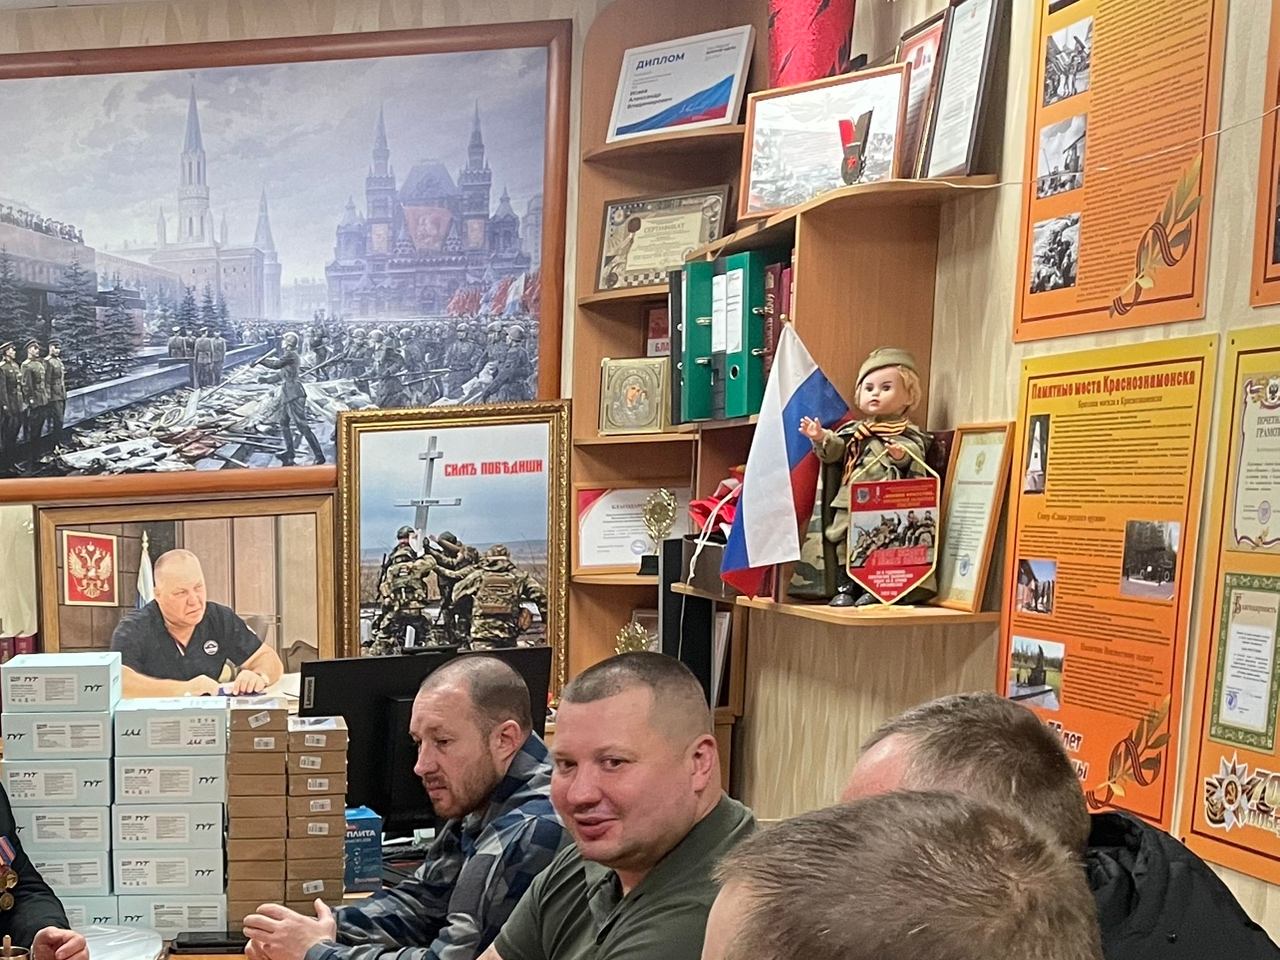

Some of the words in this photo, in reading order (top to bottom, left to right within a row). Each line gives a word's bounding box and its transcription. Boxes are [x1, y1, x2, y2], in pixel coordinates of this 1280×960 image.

[636, 52, 685, 70] ДИПЛОМ
[1031, 383, 1073, 400] Памятные
[1075, 380, 1101, 395] места
[1103, 370, 1195, 398] Краснознаменска
[84, 684, 103, 692] TYT
[199, 776, 218, 784] TYT
[347, 829, 376, 837] ПЛИТА
[124, 914, 144, 922] TYT
